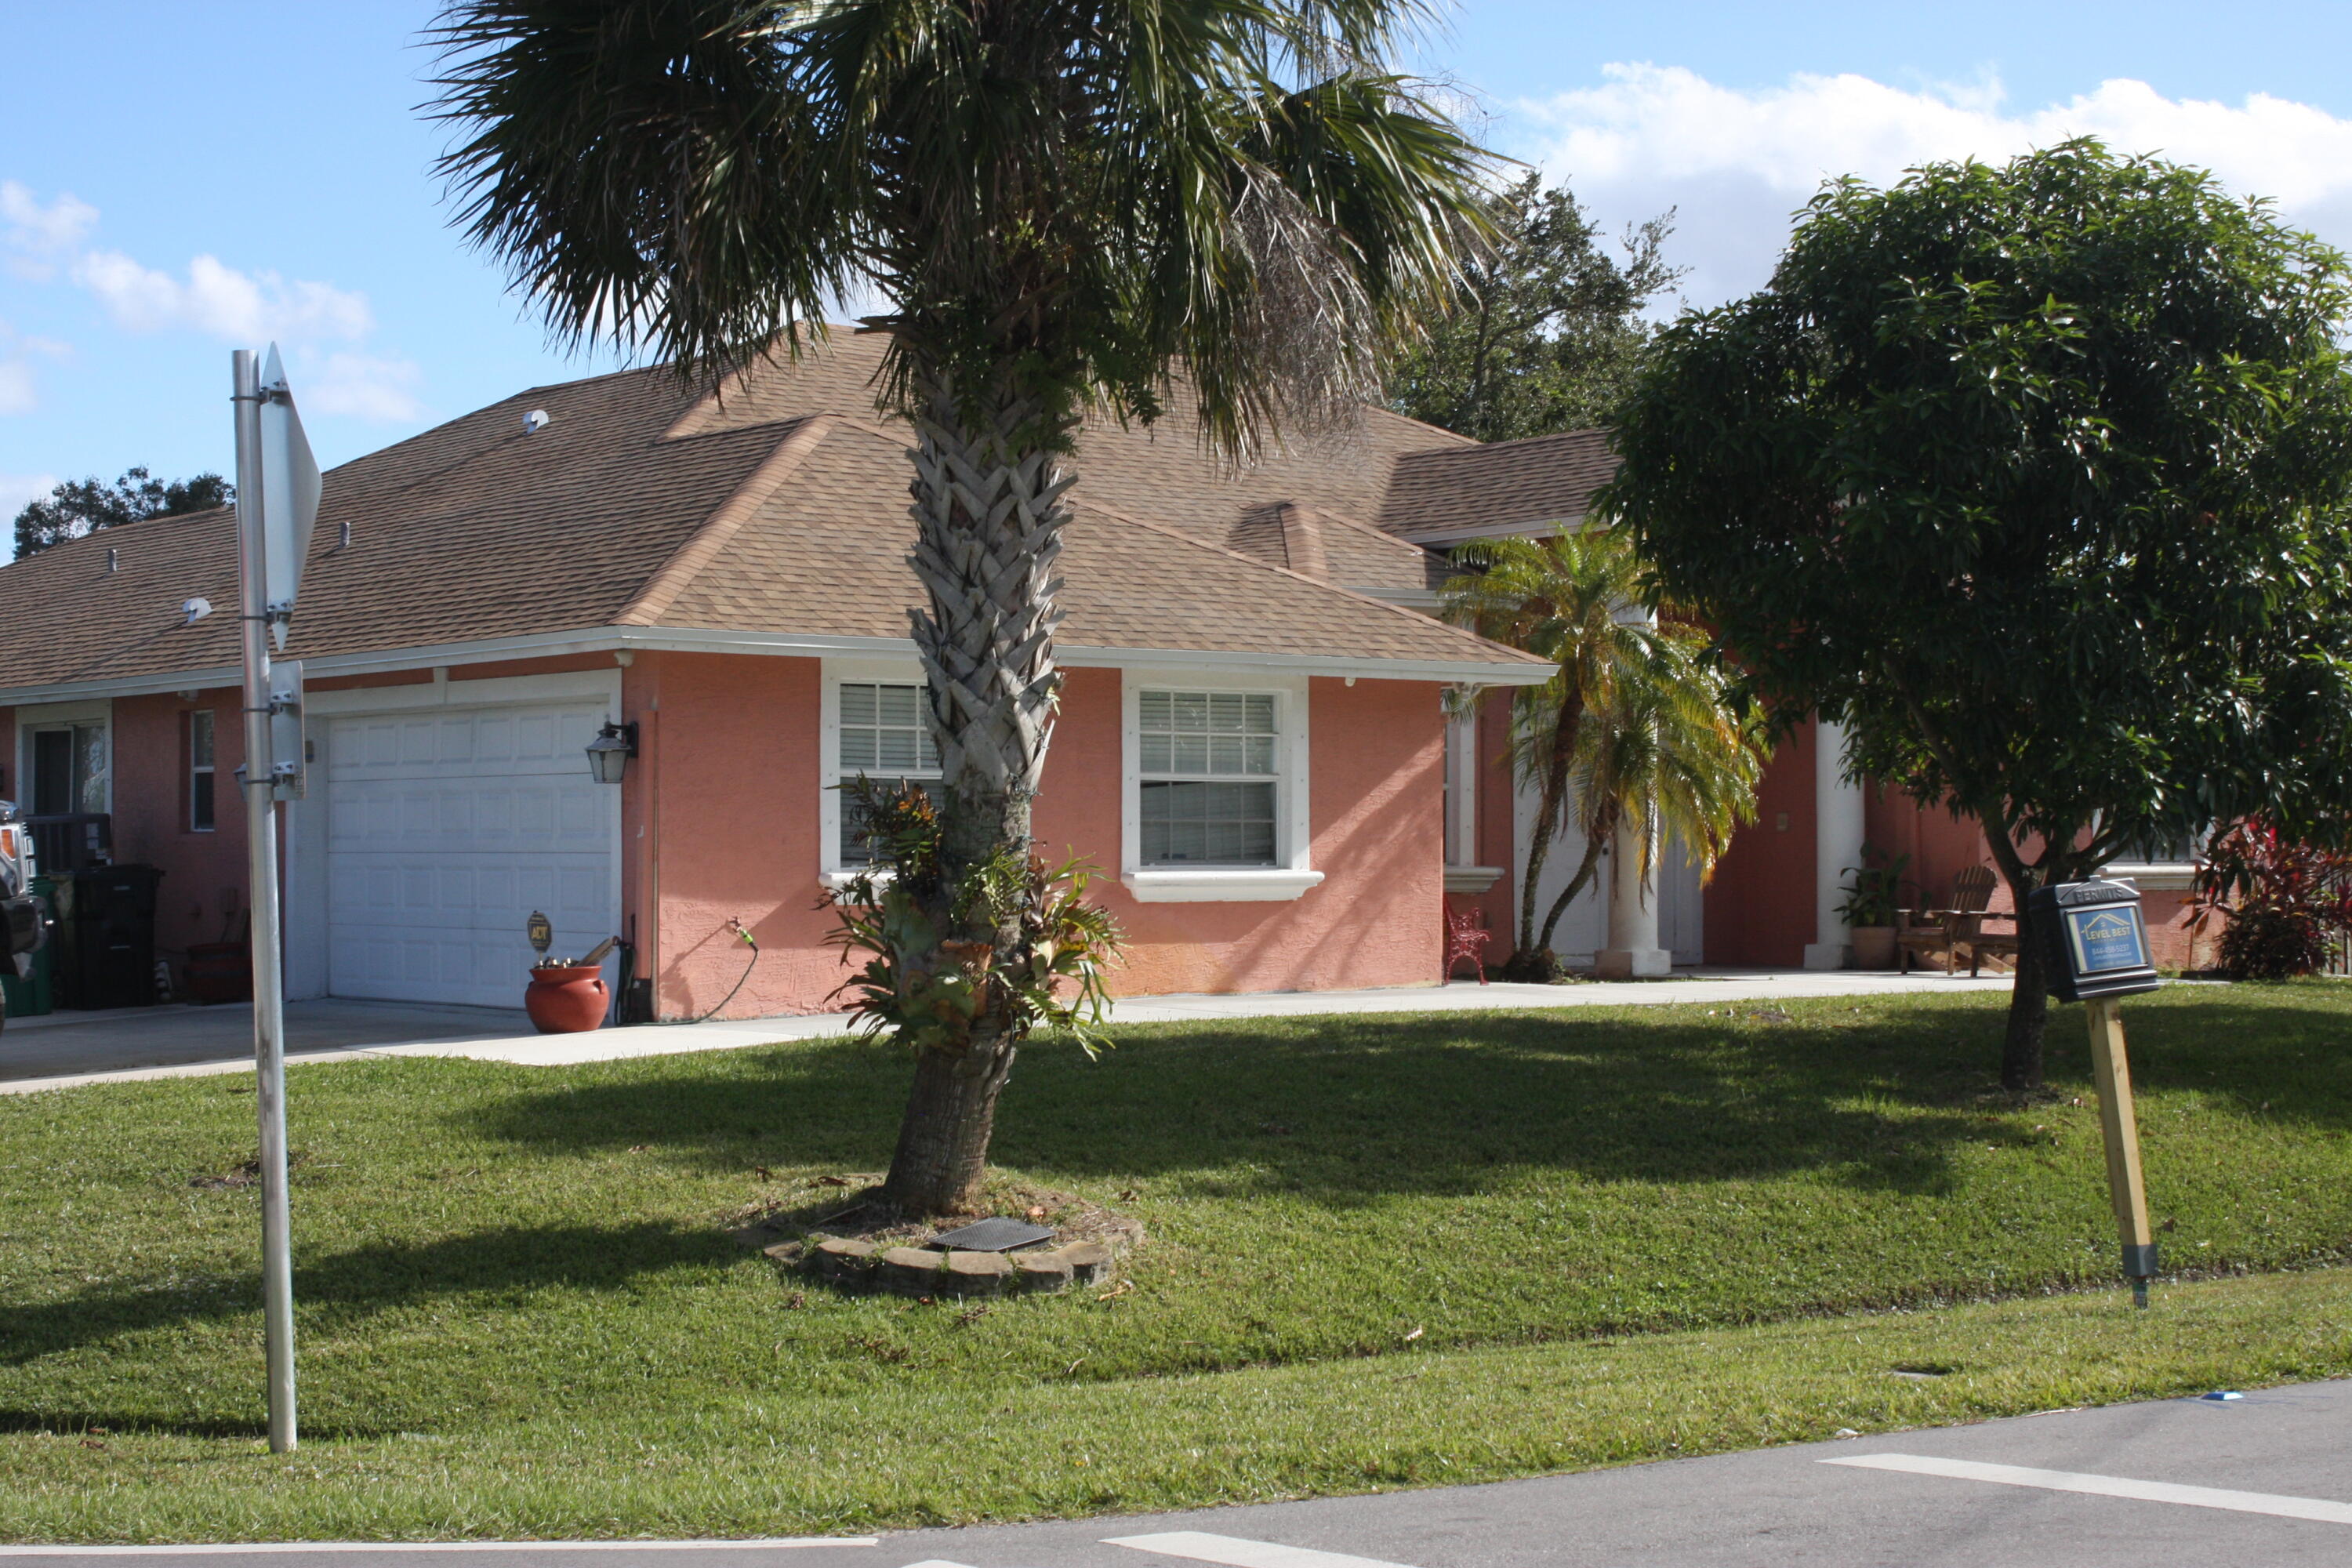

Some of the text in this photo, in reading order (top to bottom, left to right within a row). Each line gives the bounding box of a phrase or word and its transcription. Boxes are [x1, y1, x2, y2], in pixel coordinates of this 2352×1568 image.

[2074, 887, 2122, 902] PERMITS
[532, 927, 547, 940] ADT
[2085, 927, 2131, 940] LEVEL BEST
